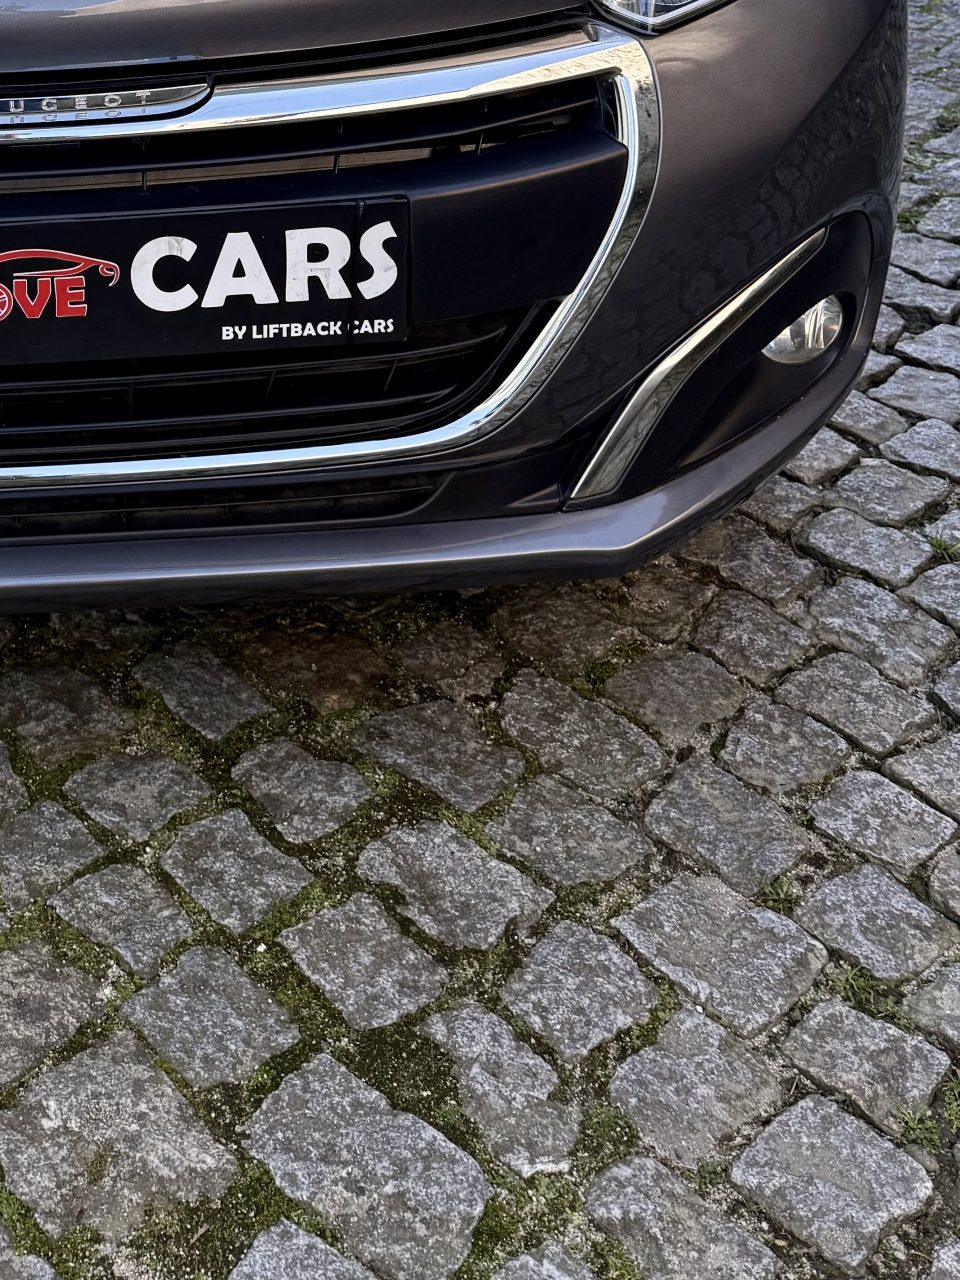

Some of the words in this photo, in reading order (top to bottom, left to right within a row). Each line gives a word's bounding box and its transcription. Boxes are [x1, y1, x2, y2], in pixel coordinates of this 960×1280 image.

[130, 220, 398, 312] CARS
[221, 325, 247, 341] BY
[252, 321, 342, 339] LIFTBACK
